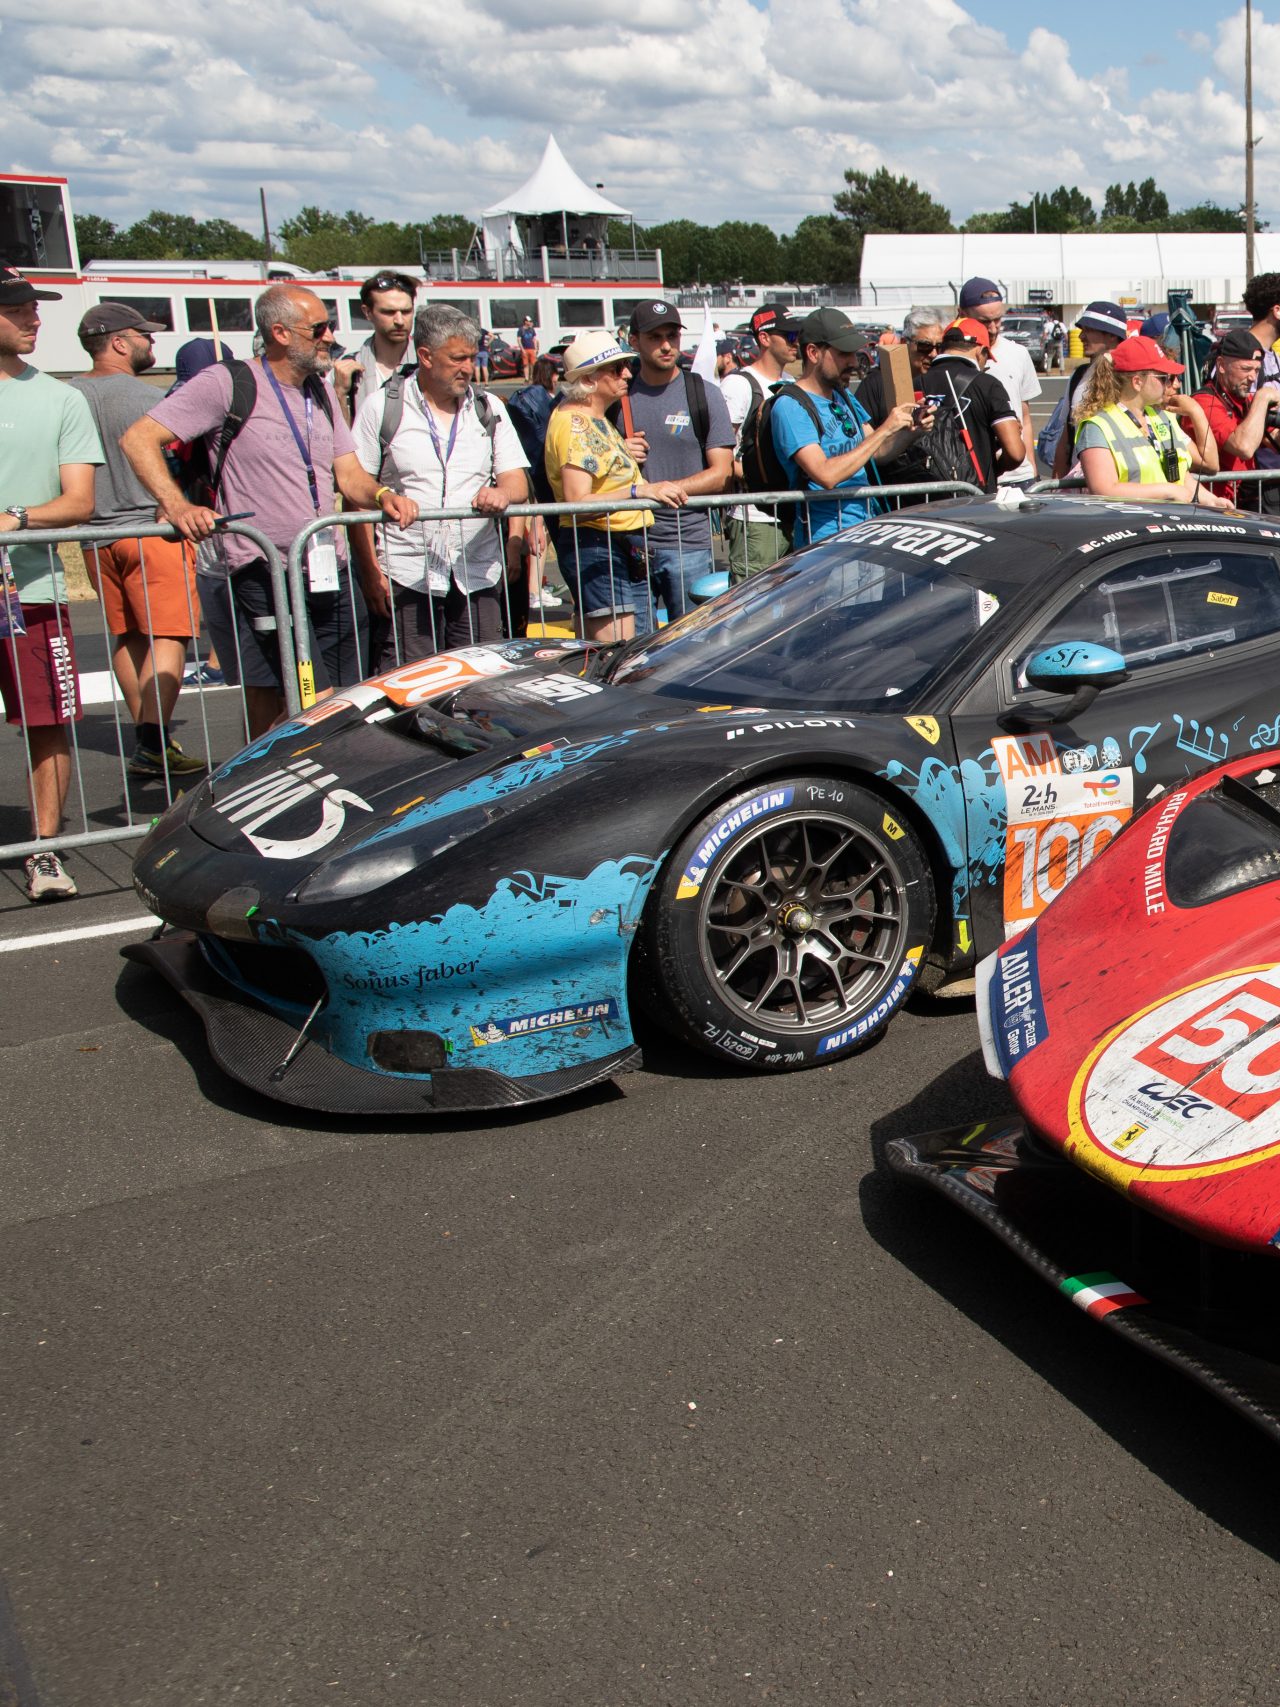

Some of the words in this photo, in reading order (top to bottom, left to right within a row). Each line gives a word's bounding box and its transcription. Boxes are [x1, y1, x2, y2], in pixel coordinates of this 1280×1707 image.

[1103, 530, 1137, 543] HULL
[1178, 524, 1246, 534] HARYANTO
[303, 677, 311, 698] TMF
[752, 719, 856, 733] PILOTI
[1007, 740, 1057, 780] AM
[1022, 783, 1057, 807] 24h
[1032, 804, 1056, 813] MANS
[698, 792, 786, 864] MICHELIN
[1146, 793, 1187, 862] RICHARD
[1144, 863, 1165, 916] MILLE
[342, 972, 410, 990] Sonus
[416, 959, 479, 994] faber
[1001, 950, 1033, 1014] ADLER
[510, 1003, 609, 1033] MICHELIN
[826, 980, 905, 1052] MICHELIN
